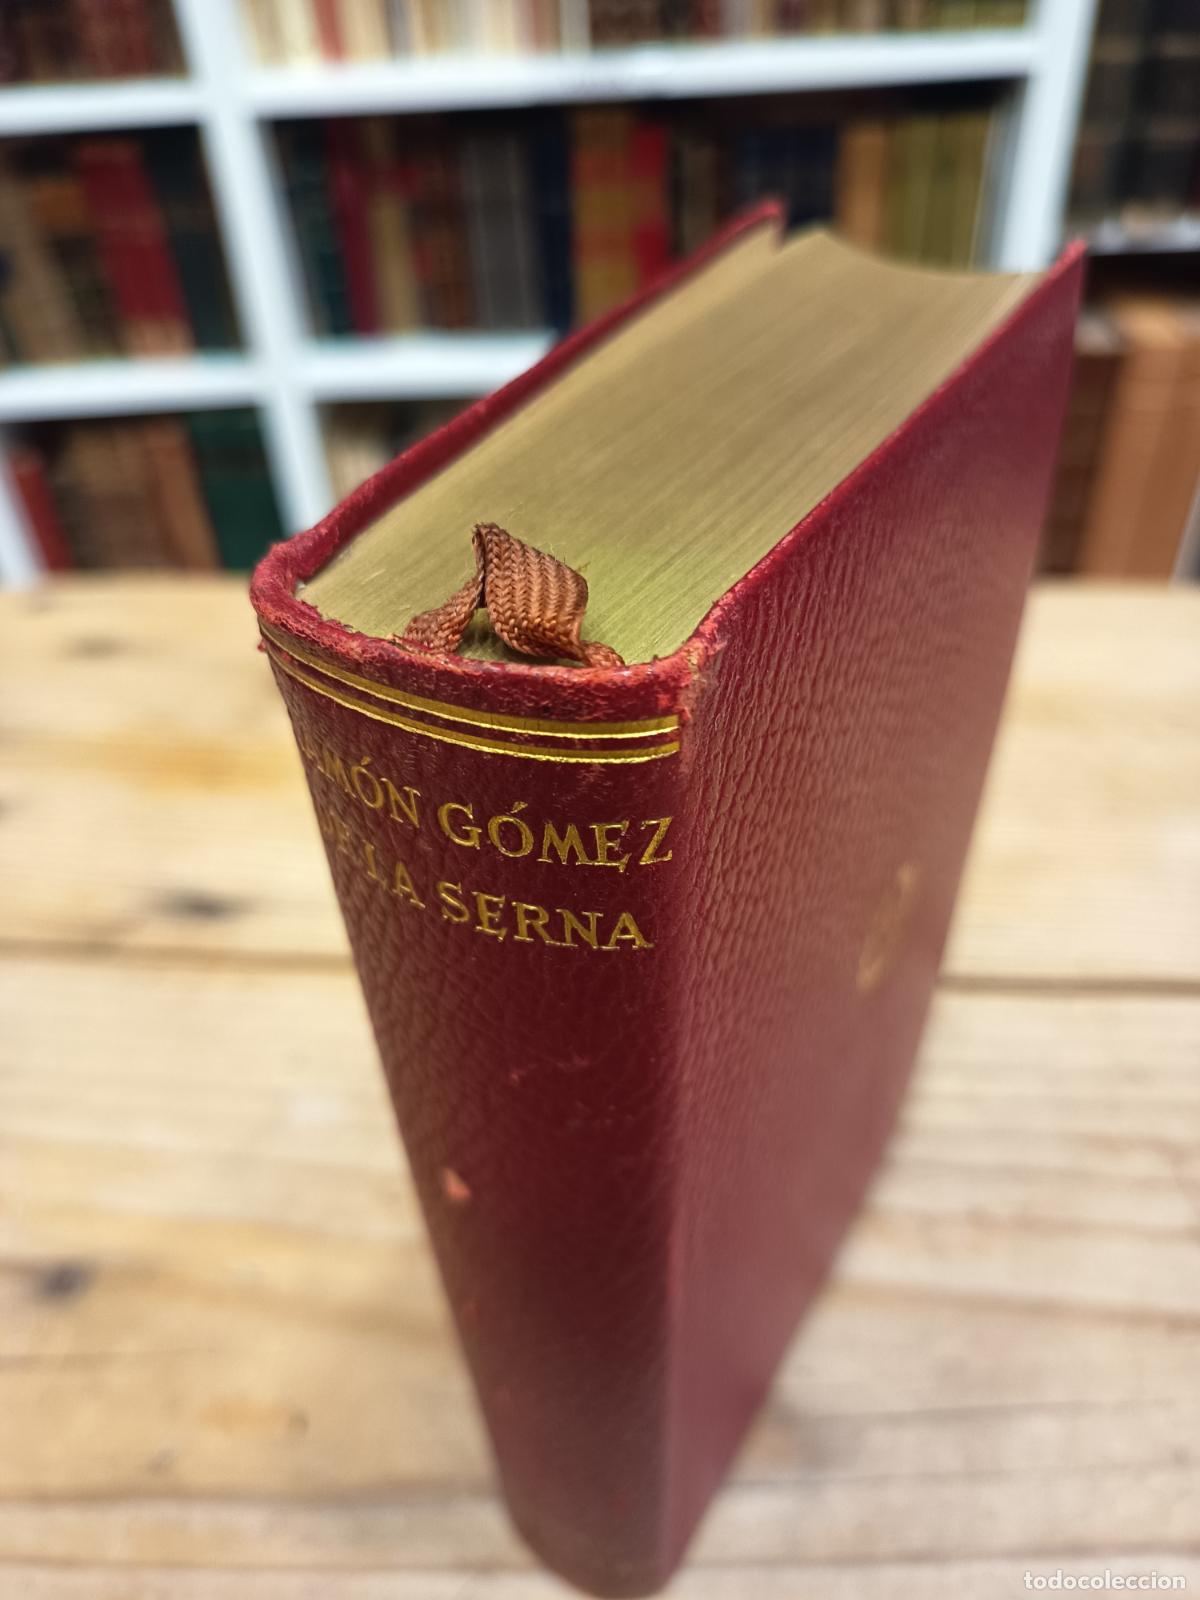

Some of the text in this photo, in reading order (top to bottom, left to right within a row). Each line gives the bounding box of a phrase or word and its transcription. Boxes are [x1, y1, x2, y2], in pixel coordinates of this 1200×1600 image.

[437, 801, 673, 872] GÓMEZ
[363, 839, 426, 908] LA
[437, 881, 654, 950] SERNA
